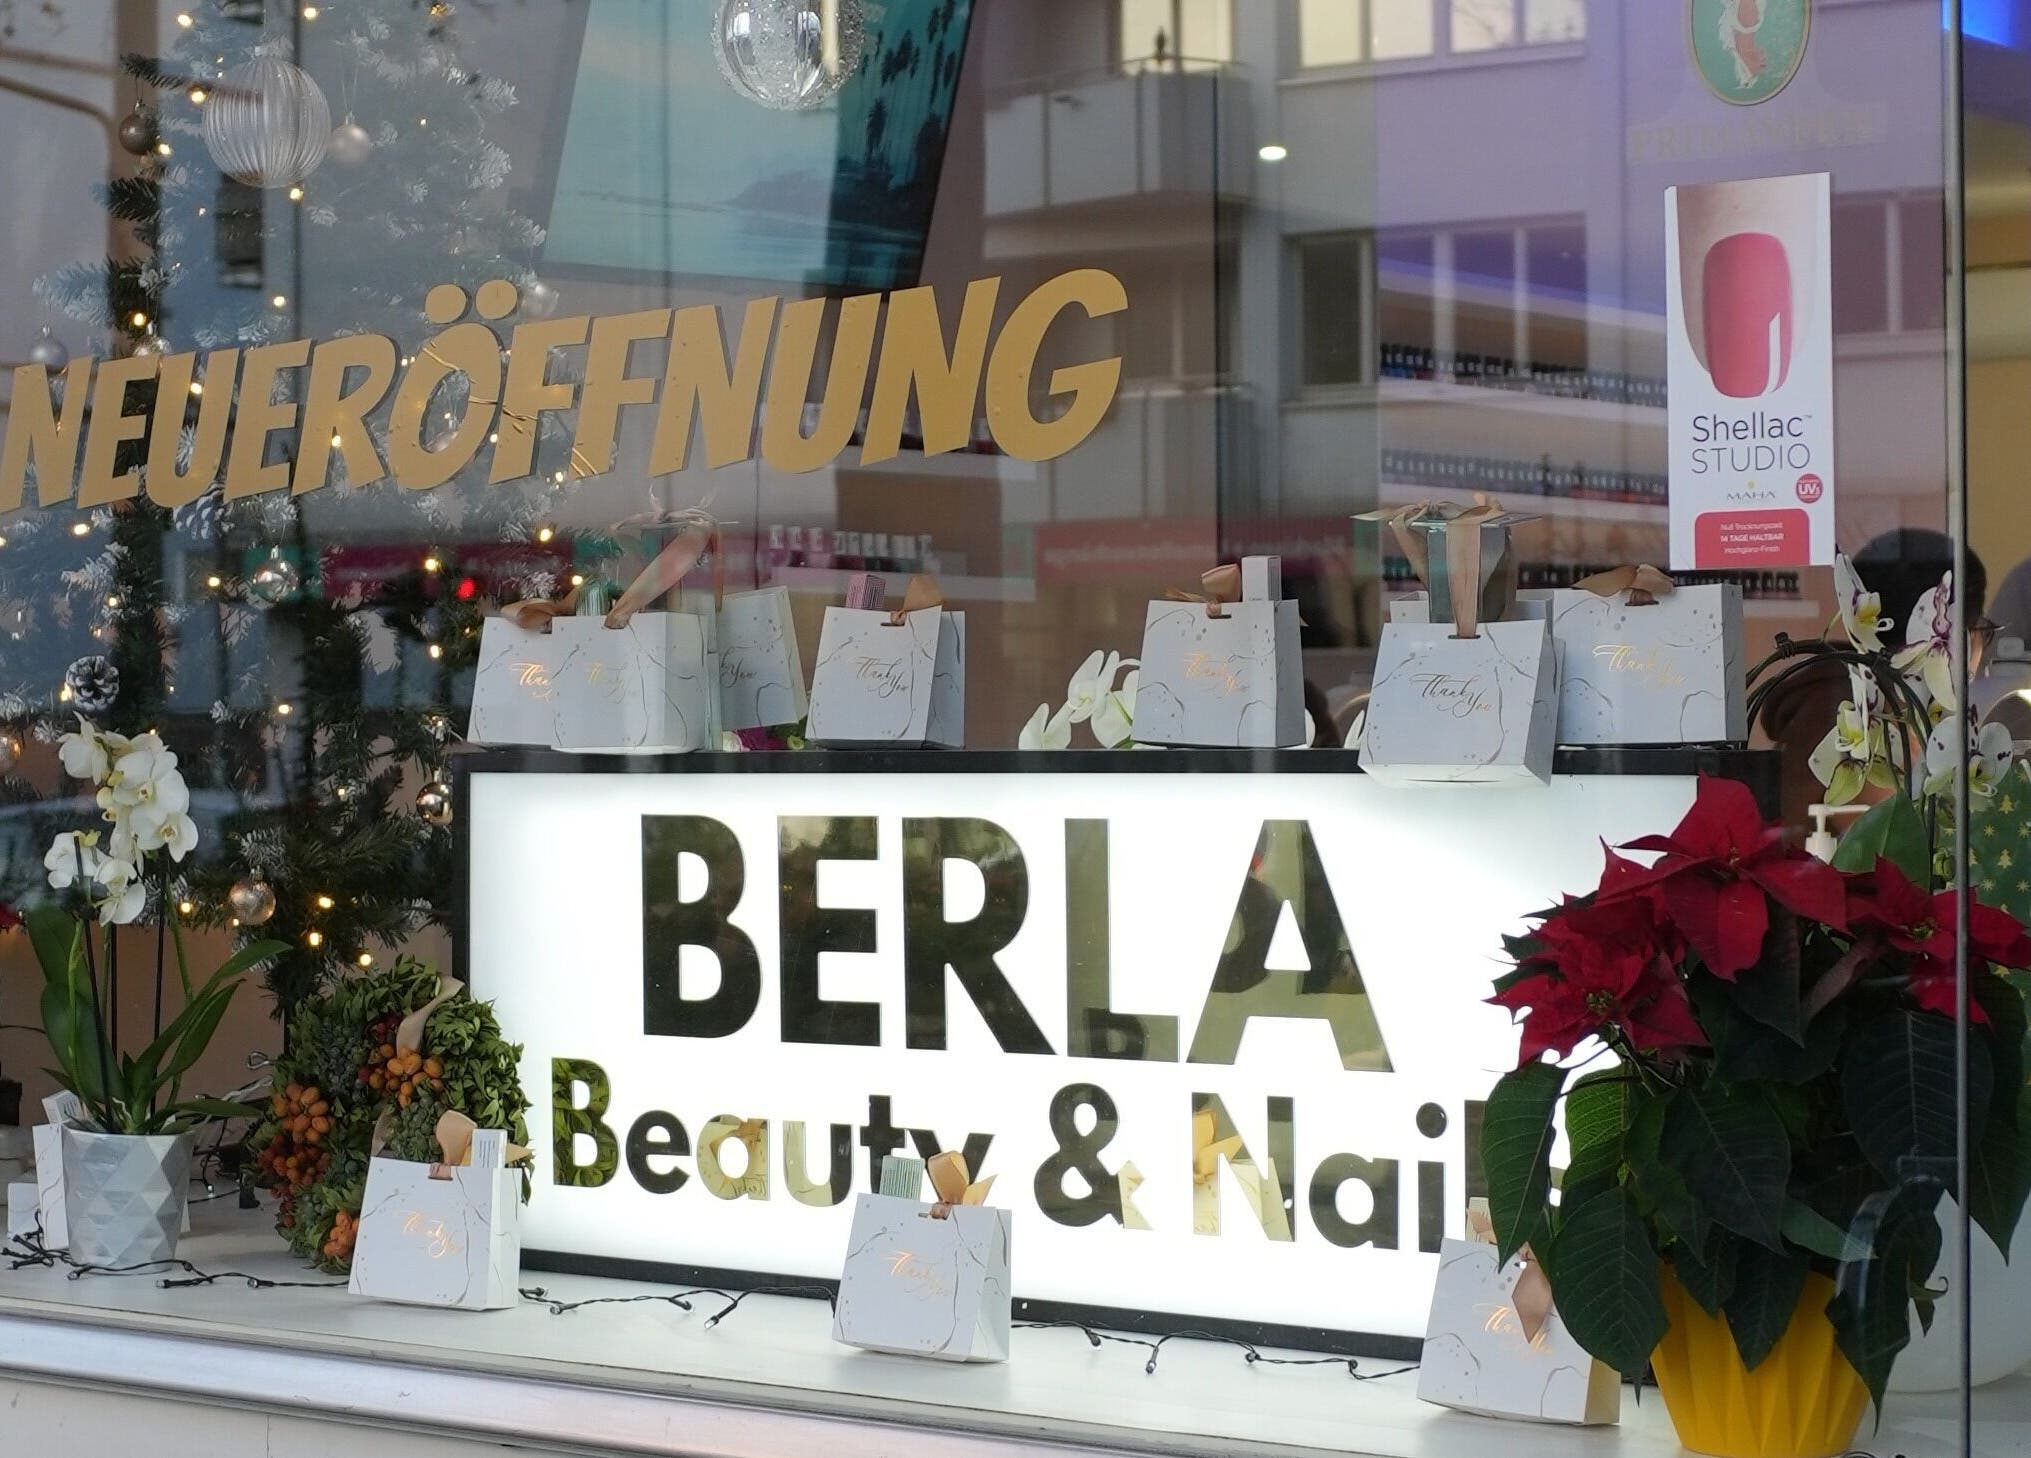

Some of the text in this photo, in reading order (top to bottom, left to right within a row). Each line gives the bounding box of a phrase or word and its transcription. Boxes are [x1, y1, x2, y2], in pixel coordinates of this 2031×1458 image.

[0, 268, 1128, 512] NEUERÖFFNUNG
[1692, 411, 1804, 442] Shellac
[1691, 443, 1810, 474] STUDIO
[1410, 673, 1480, 697] Thank
[641, 813, 1394, 1073] BERLA
[1034, 1082, 1152, 1231] &
[1191, 1092, 1567, 1254] Nail
